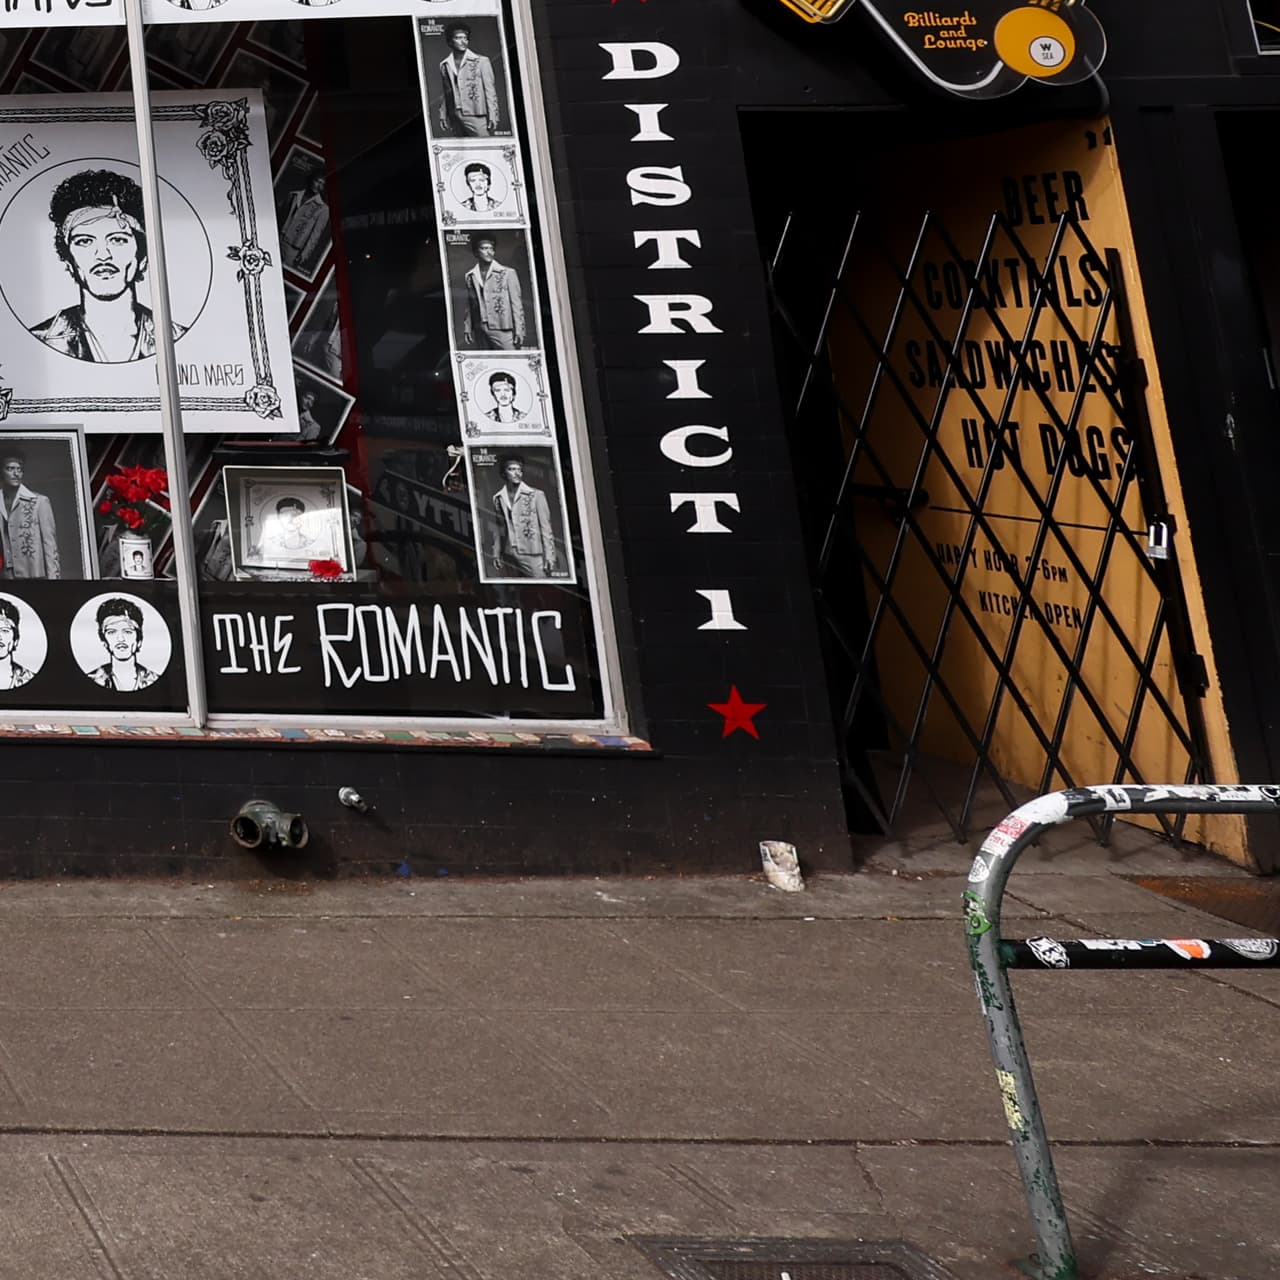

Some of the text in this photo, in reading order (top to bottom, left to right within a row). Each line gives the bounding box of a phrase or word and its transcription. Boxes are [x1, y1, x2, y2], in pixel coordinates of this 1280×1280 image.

[903, 11, 977, 28] Billiards
[940, 25, 967, 38] and
[923, 34, 986, 51] Lounge
[1041, 43, 1052, 52] W
[1002, 170, 1090, 227] BEER
[597, 40, 749, 632] DISTRICT 1
[204, 363, 246, 387] MARS
[961, 417, 1137, 483] HOT DOGS
[1044, 602, 1083, 631] OPEN
[212, 602, 578, 692] THE ROMANTIC
